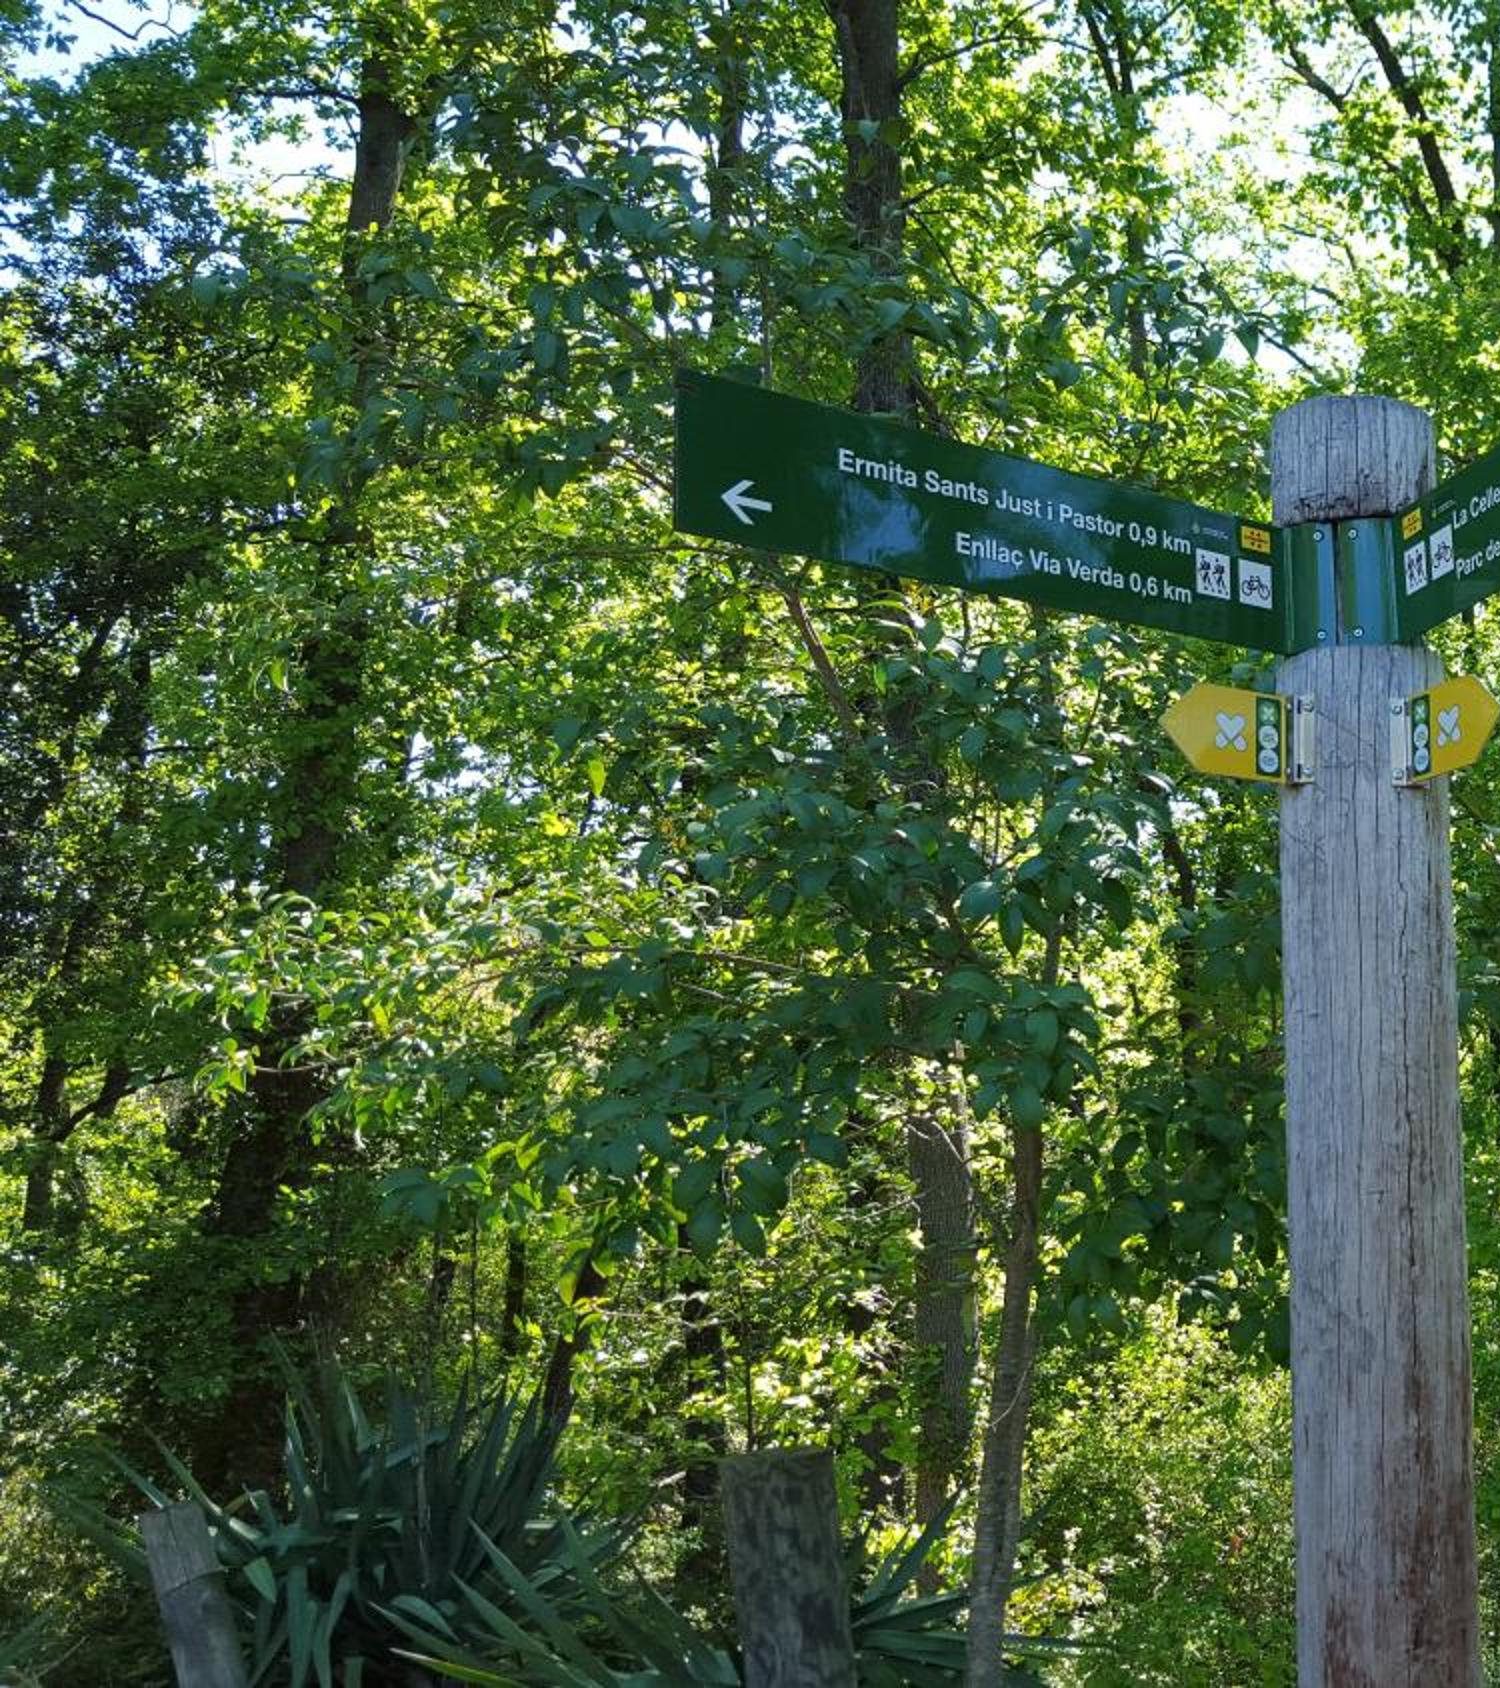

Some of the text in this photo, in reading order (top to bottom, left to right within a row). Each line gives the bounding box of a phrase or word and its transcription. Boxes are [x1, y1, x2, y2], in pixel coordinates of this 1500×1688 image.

[838, 448, 917, 488] Ermita
[924, 470, 990, 505] Sants
[996, 489, 1042, 517] Just
[1047, 501, 1053, 521] i
[1058, 504, 1124, 539] Pastor
[1128, 521, 1158, 548] 0,9
[1162, 529, 1191, 555] km
[1452, 509, 1468, 530] La
[956, 532, 1192, 604] Enllaç Via Verda 0,6 km
[1455, 553, 1484, 579] Parc
